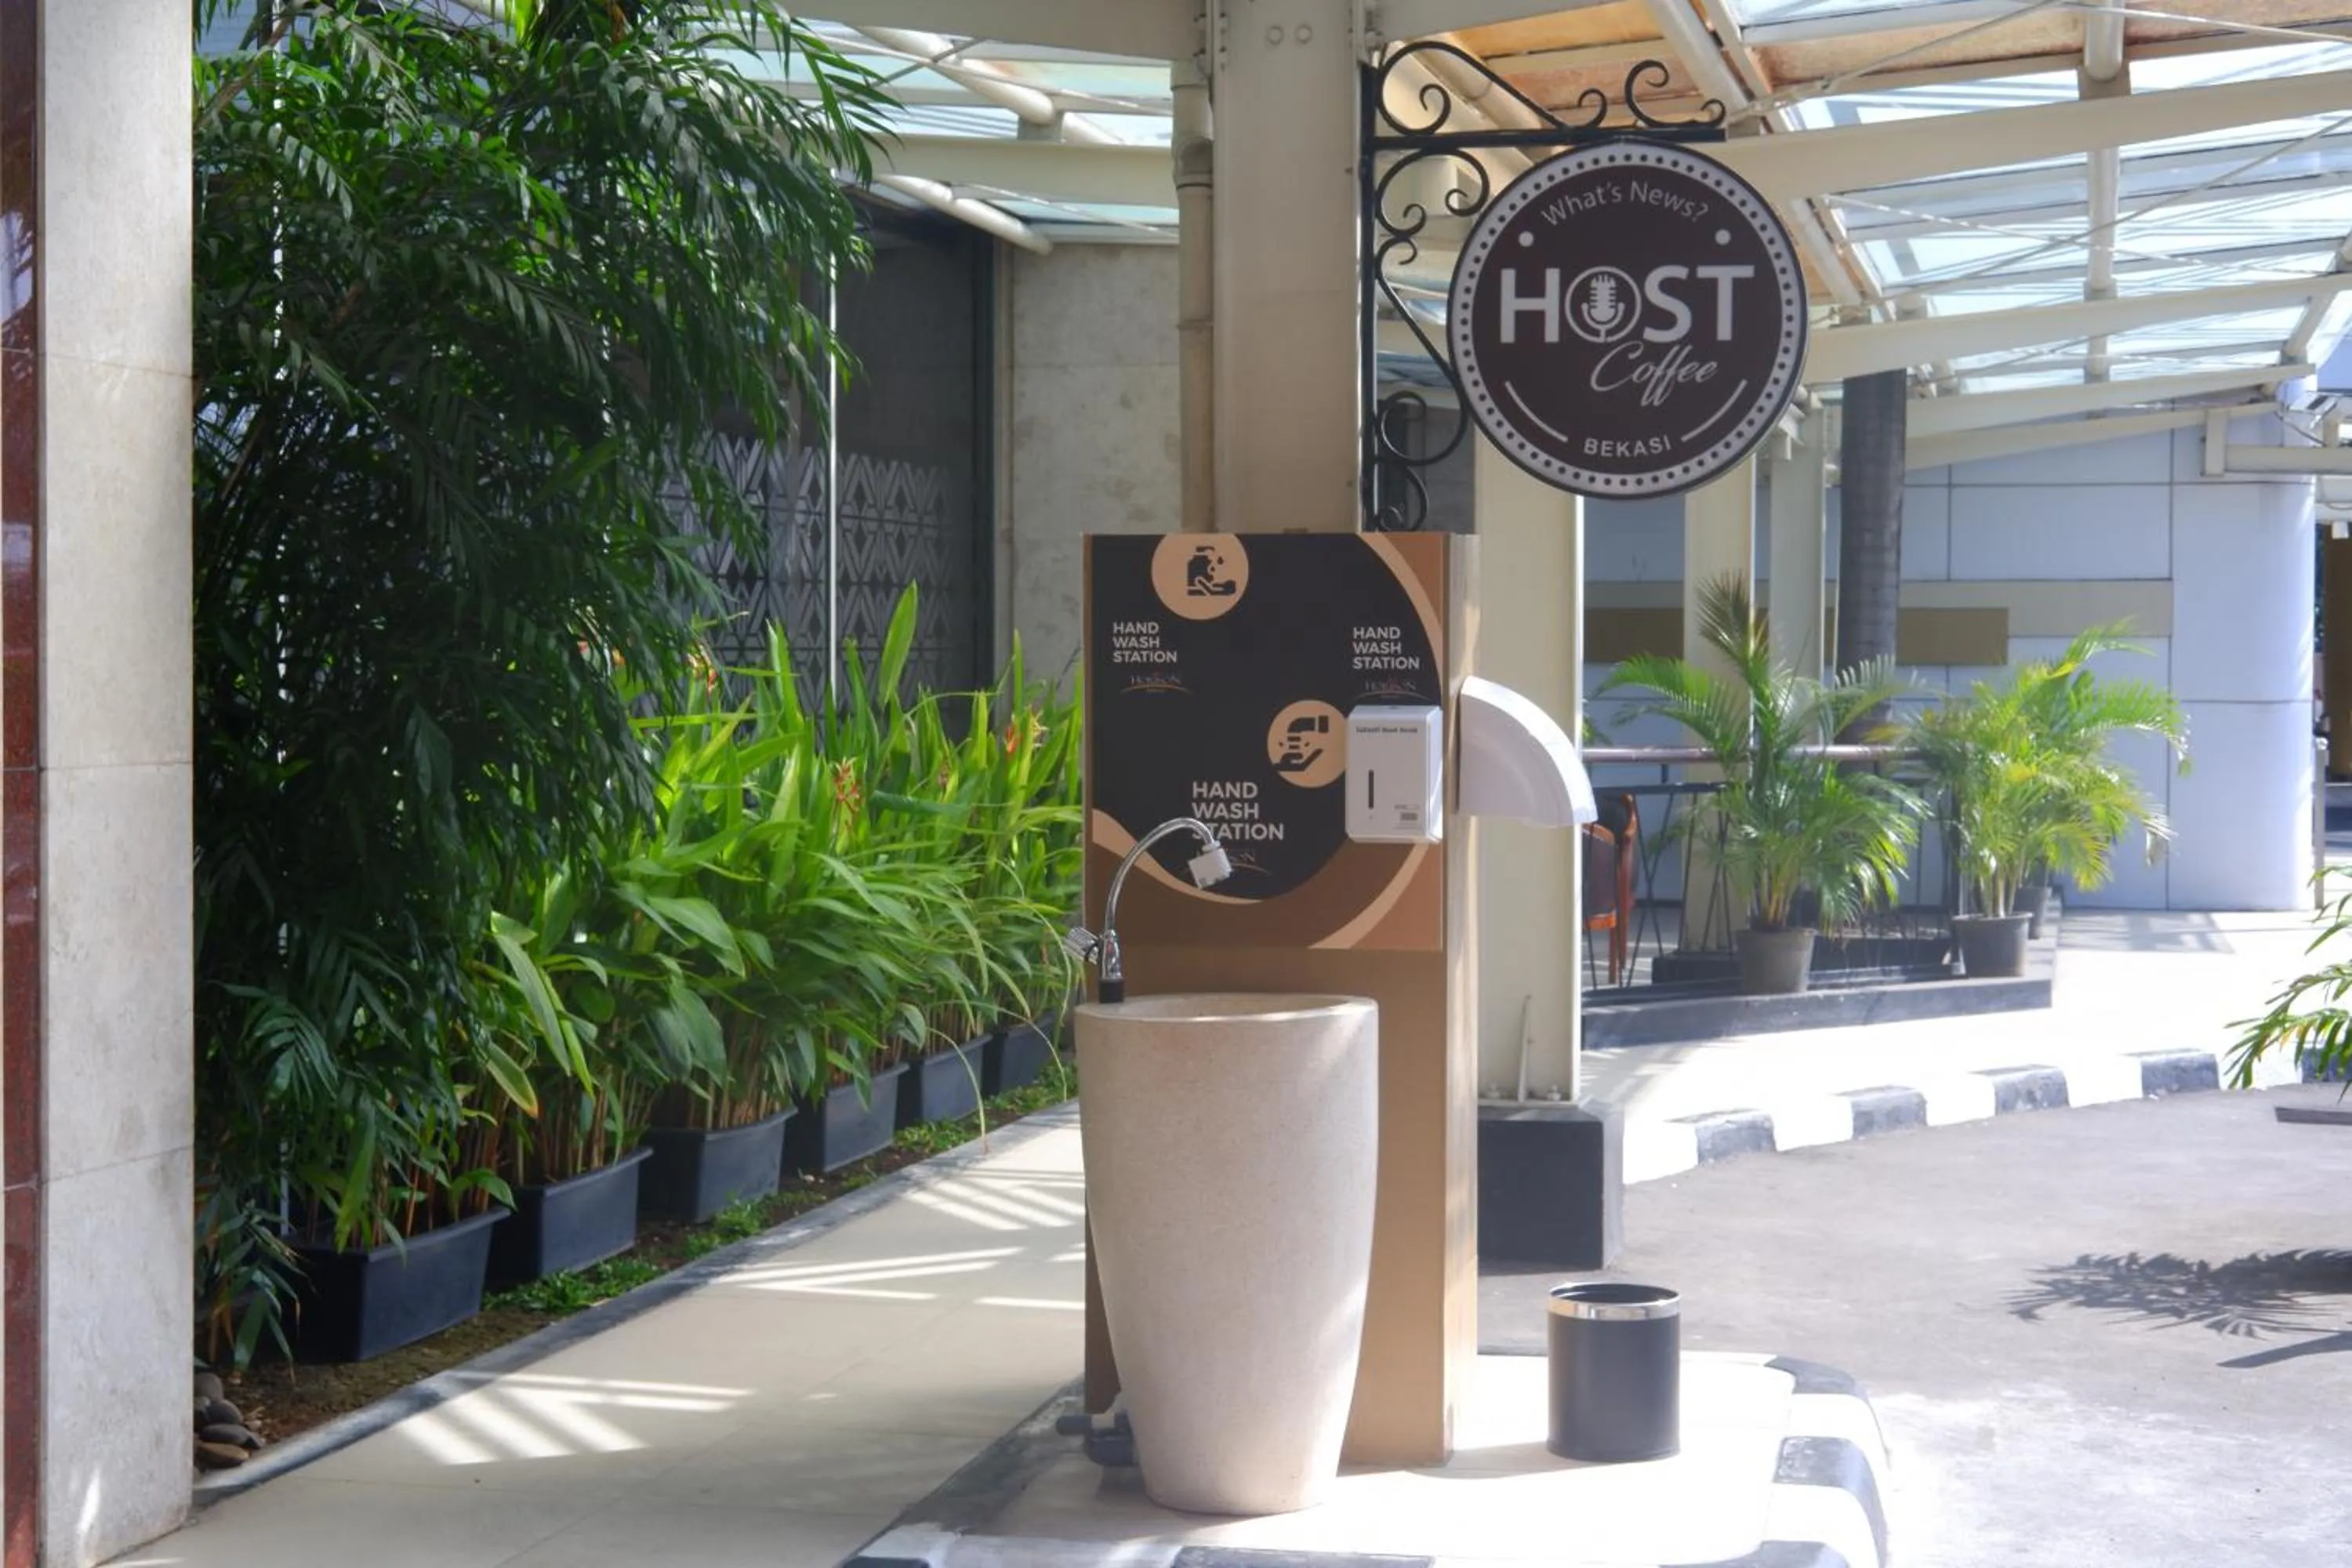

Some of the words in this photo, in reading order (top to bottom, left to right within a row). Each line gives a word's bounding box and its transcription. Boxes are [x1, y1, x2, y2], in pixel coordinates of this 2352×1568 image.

[1541, 182, 1622, 226] What's
[1630, 180, 1709, 223] News?
[1499, 264, 1755, 343] HOST
[1590, 340, 1719, 407] Coffee
[1583, 434, 1671, 458] BEKASI
[1112, 621, 1160, 634] HAND
[1352, 626, 1402, 639] HAND
[1112, 636, 1160, 648] WASH
[1352, 641, 1403, 655] WASH
[1112, 650, 1178, 663] STATION
[1352, 655, 1421, 670] STATION
[1192, 781, 1258, 799] HAND
[1191, 802, 1260, 820] WASH
